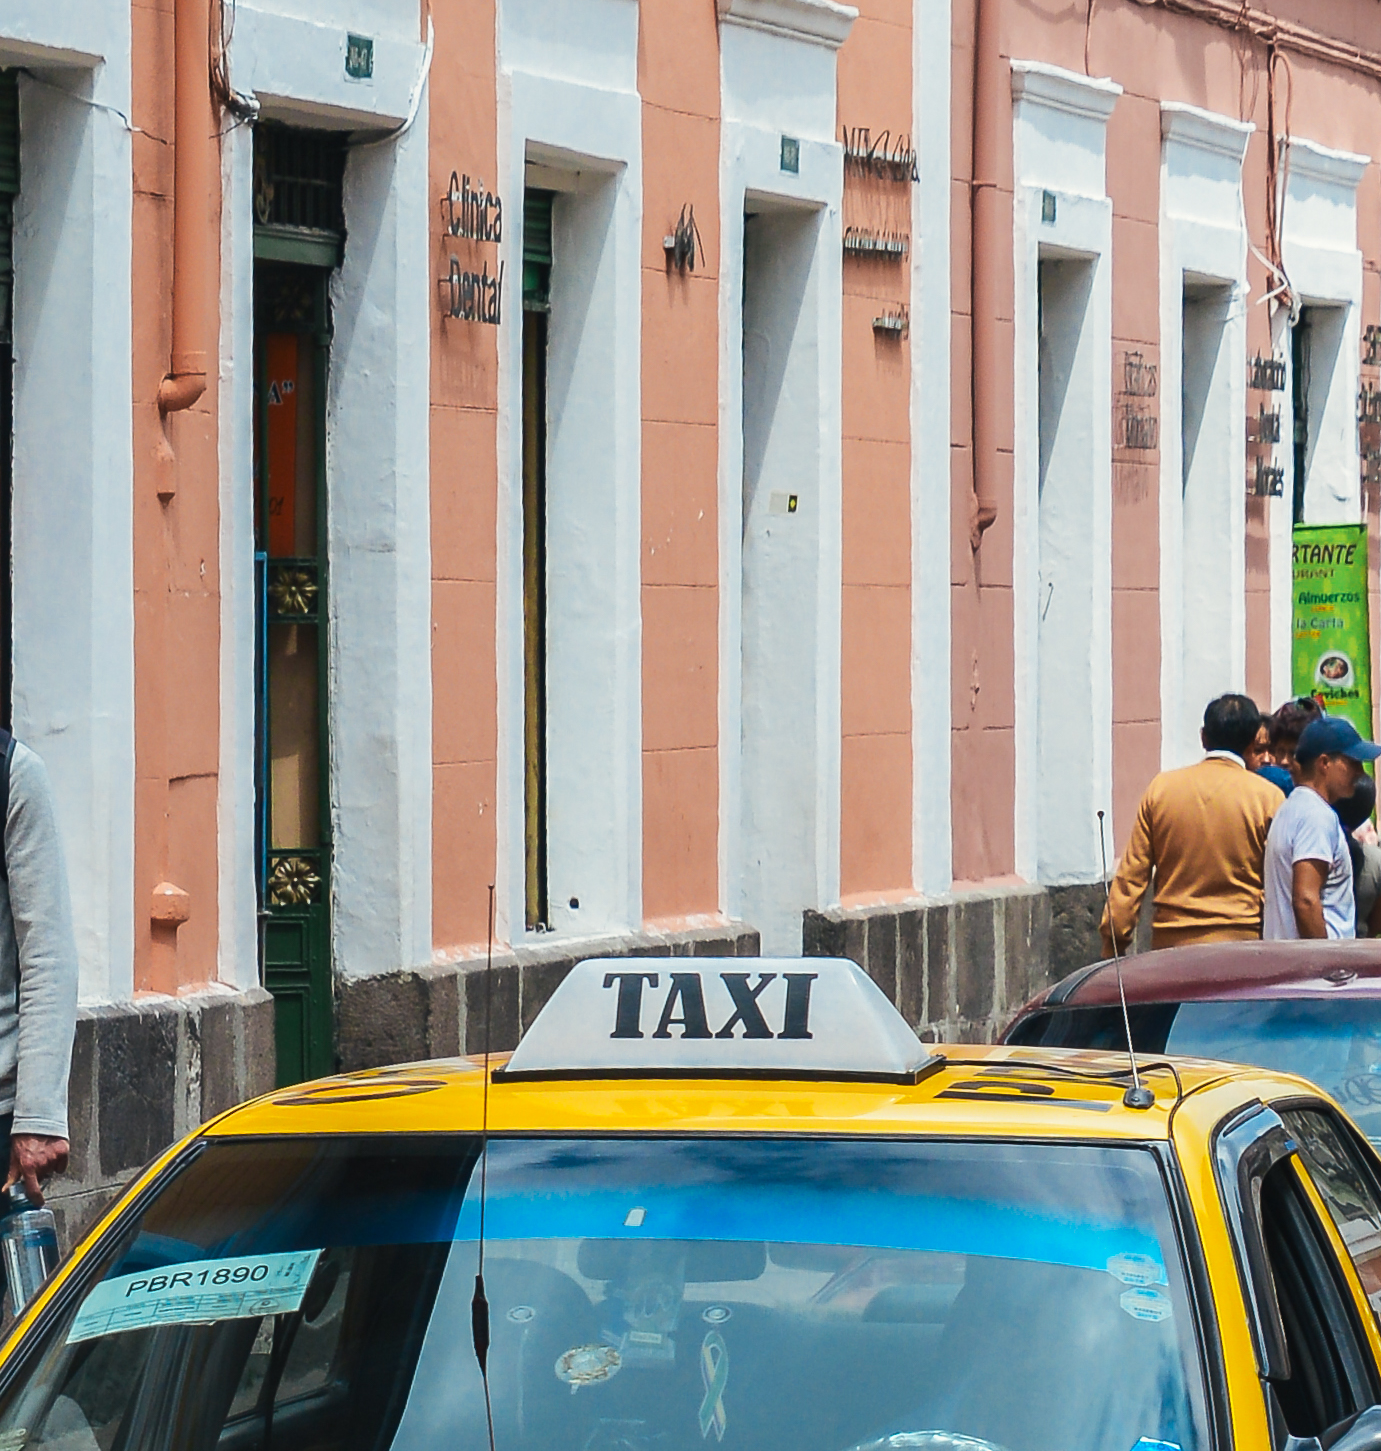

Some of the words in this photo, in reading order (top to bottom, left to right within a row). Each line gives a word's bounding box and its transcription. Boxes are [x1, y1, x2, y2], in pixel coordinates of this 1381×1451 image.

[449, 171, 502, 243] Clinica
[450, 253, 504, 325] Dental
[1298, 591, 1360, 605] Almuerzos
[1310, 687, 1360, 700] Cviches
[602, 972, 819, 1039] TAXI
[125, 1264, 270, 1298] PBR1890
